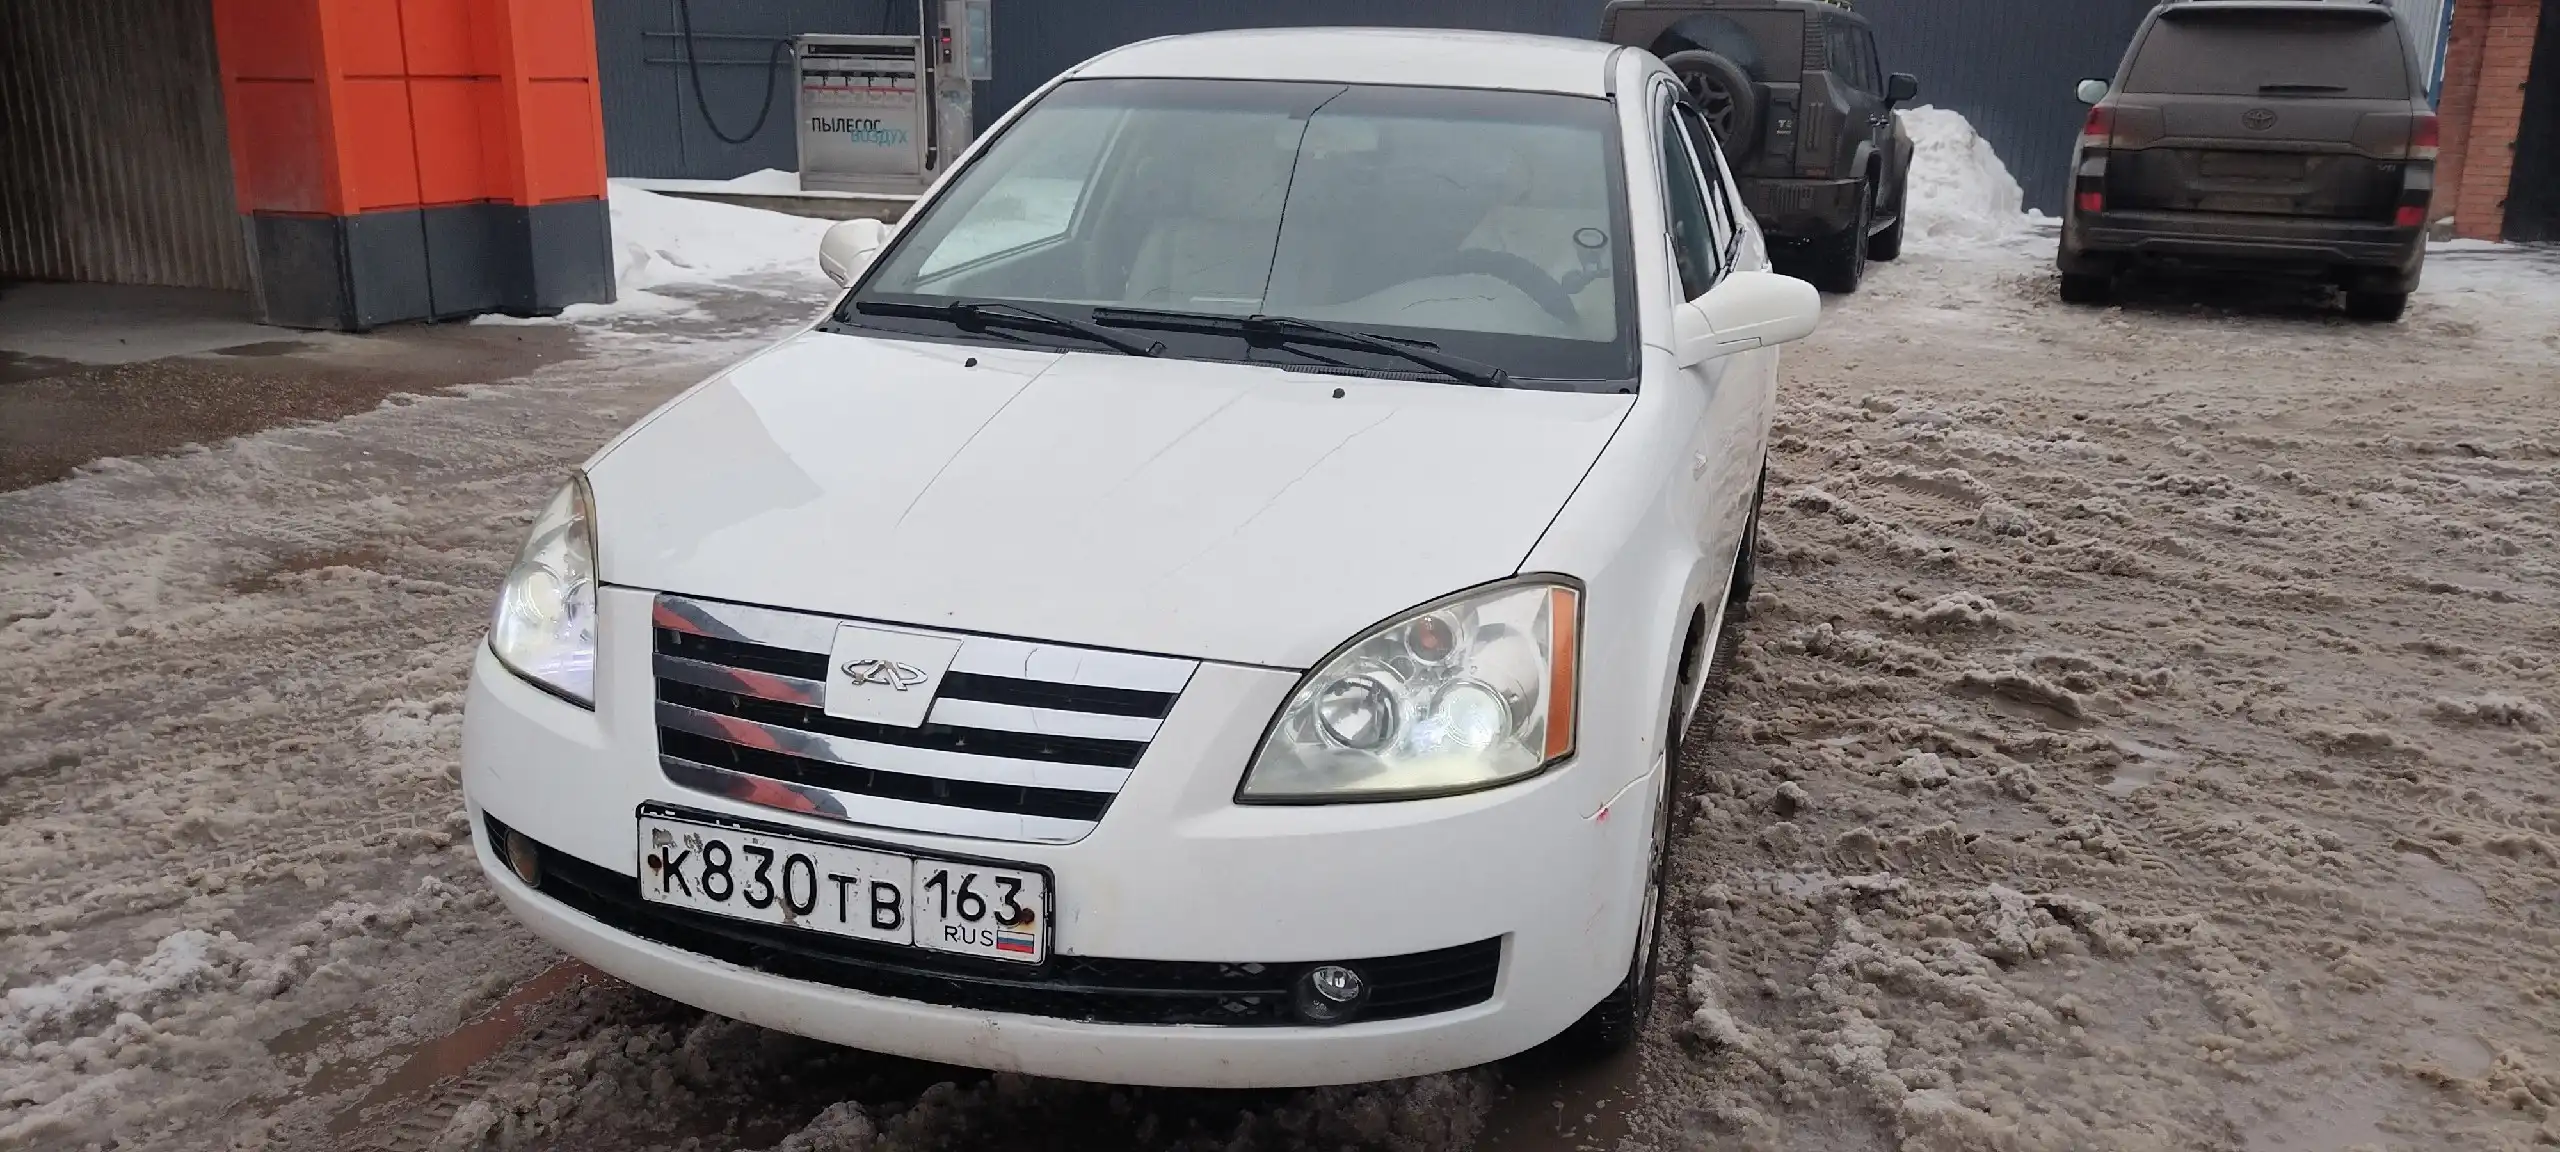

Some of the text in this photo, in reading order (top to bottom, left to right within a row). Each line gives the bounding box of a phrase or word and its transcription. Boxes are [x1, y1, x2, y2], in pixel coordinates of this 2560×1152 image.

[811, 117, 881, 133] ПЫЛЕСОС
[850, 129, 908, 147] ВОЗДУХ
[661, 839, 1022, 931] К830ТВ 163
[943, 926, 994, 947] RUS
